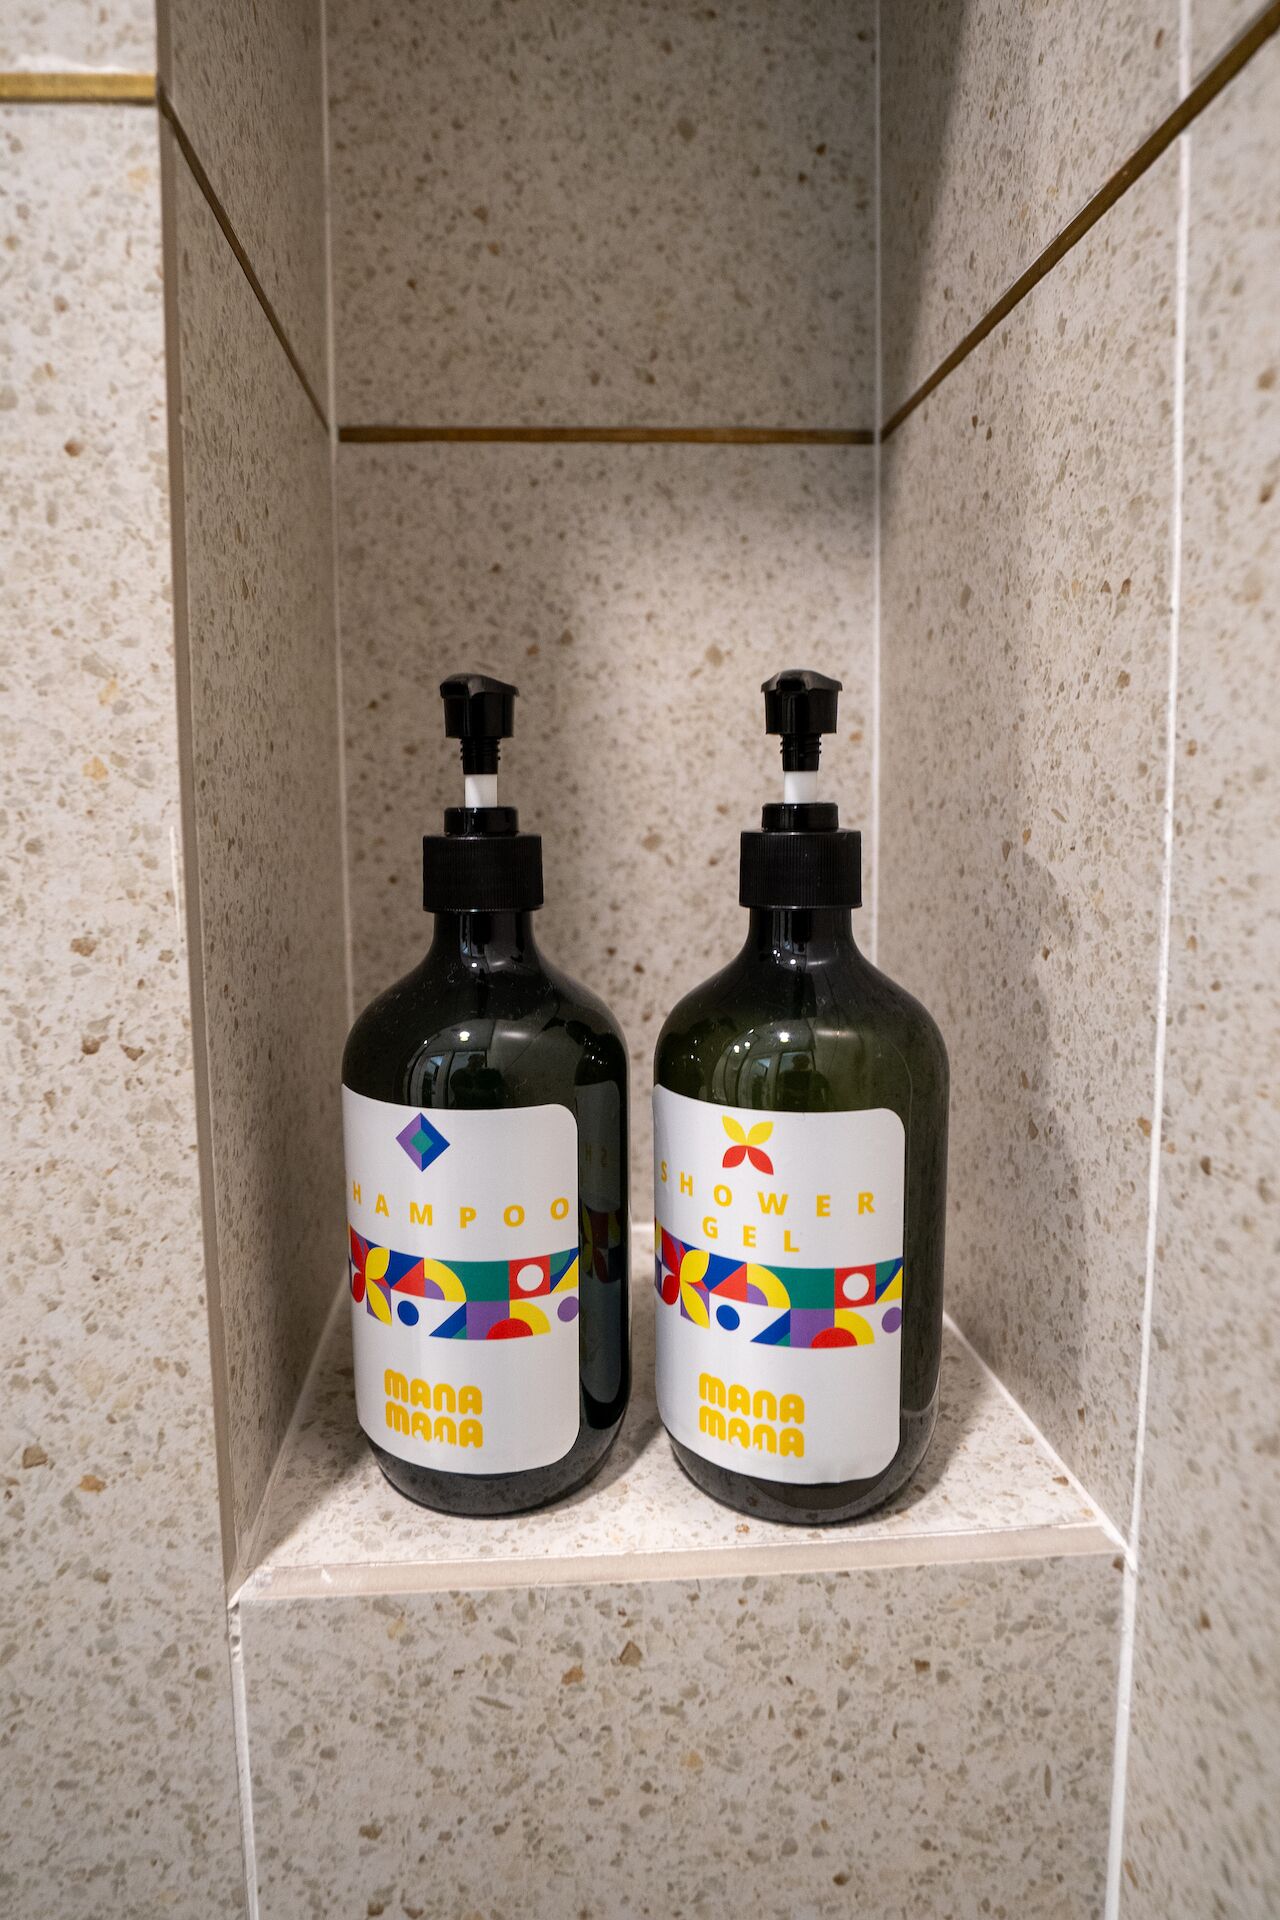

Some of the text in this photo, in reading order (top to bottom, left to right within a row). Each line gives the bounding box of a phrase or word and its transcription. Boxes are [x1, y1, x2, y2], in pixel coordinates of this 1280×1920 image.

[352, 1180, 570, 1230] HAMPOO
[660, 1160, 876, 1217] SHOWER
[702, 1215, 801, 1253] GEL
[384, 1368, 484, 1416] MANA
[698, 1372, 806, 1425] MANA
